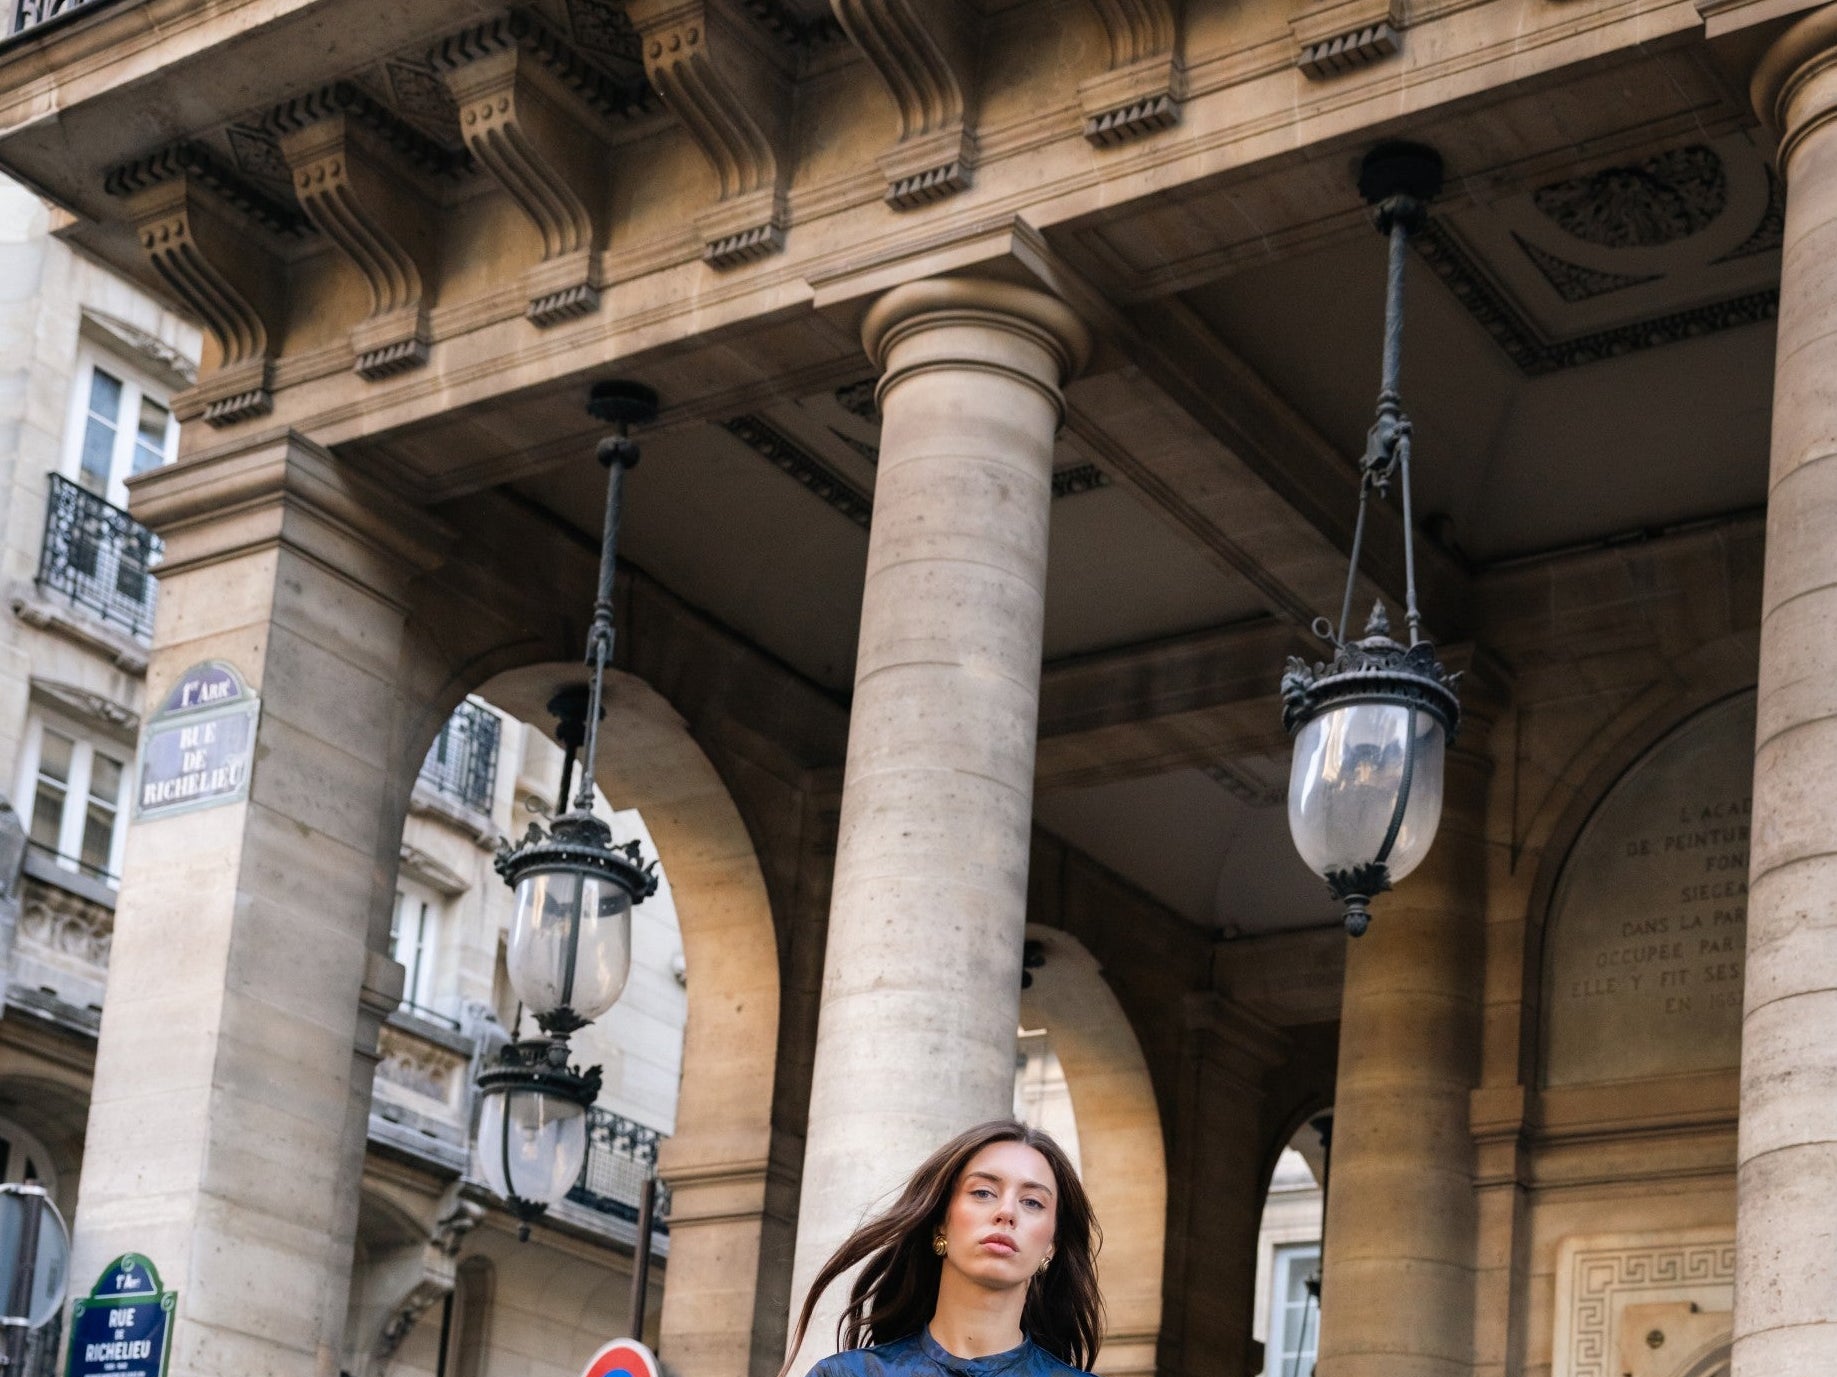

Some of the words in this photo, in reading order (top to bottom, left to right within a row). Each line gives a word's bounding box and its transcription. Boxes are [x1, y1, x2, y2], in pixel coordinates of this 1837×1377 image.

[180, 721, 217, 750] RUE
[182, 749, 207, 773] DE
[143, 761, 245, 805] RICHELIEU
[1626, 839, 1650, 858] DE
[1705, 853, 1748, 873] FON
[1680, 915, 1703, 930] LA
[1699, 936, 1734, 954] PAR
[1630, 974, 1643, 991] Y
[1660, 969, 1689, 988] FIT
[1703, 962, 1741, 983] SES
[108, 1307, 136, 1328] RUE
[114, 1329, 125, 1340] DE
[85, 1340, 151, 1362] RICHELIEU
